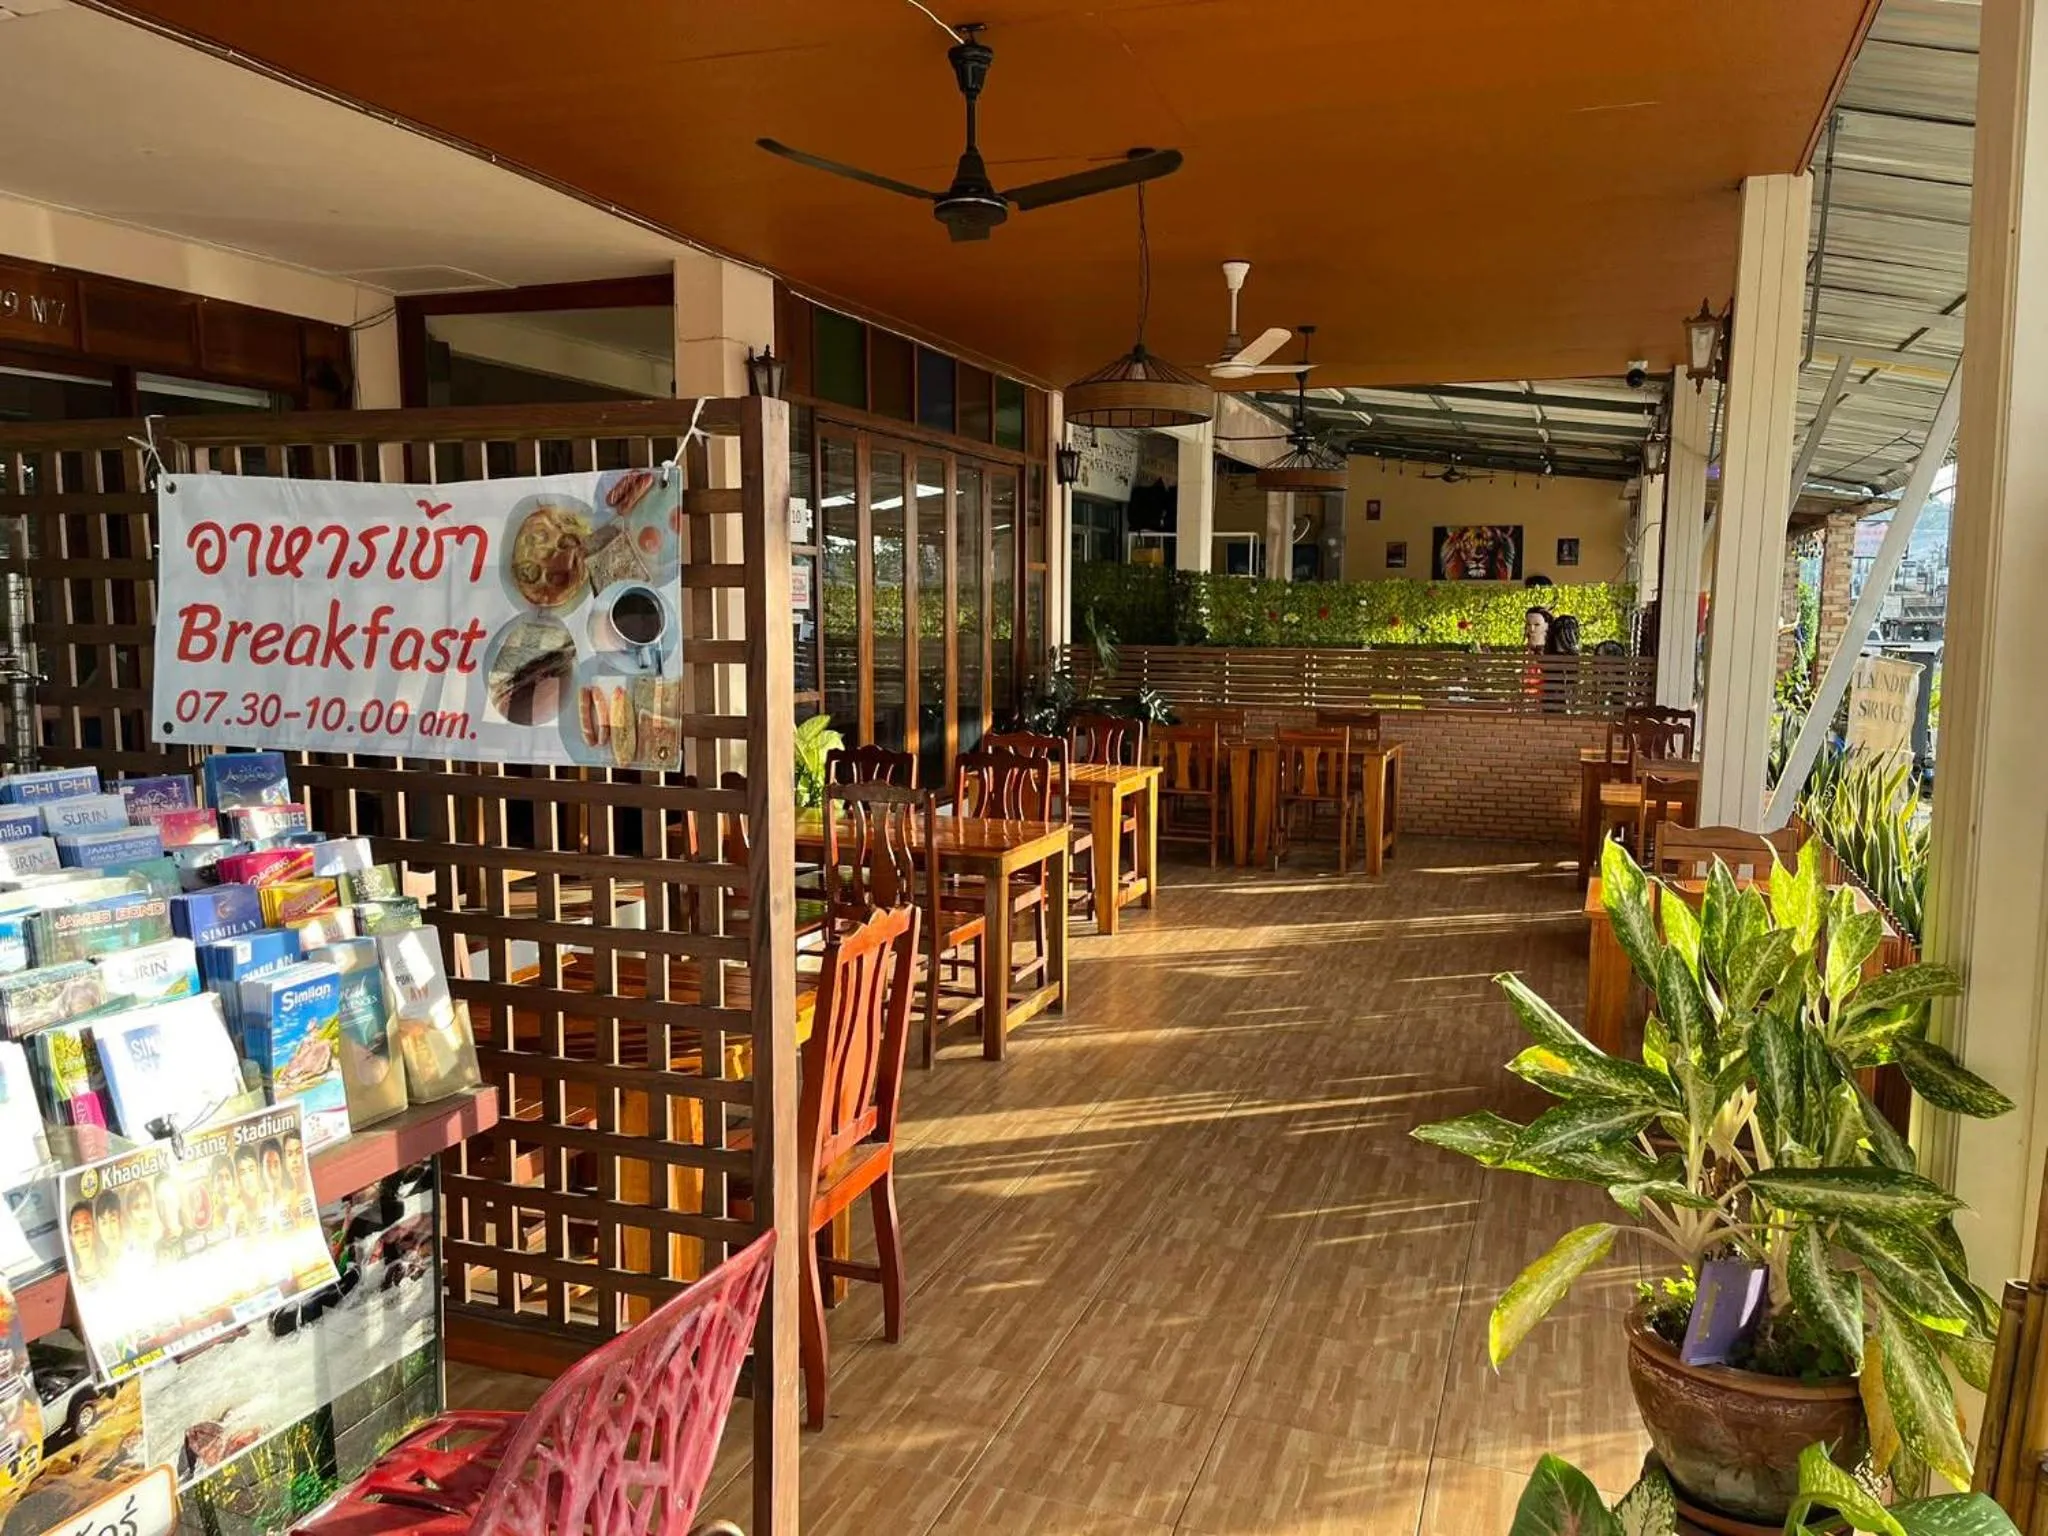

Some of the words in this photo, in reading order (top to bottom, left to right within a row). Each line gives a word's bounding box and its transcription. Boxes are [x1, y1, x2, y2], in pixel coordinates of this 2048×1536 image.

[187, 499, 489, 583] อาหารเช้า
[176, 598, 487, 674] Breakfast
[175, 689, 408, 735] 07.30-10.00
[418, 710, 478, 740] am.
[21, 783, 54, 797] PHI
[58, 777, 92, 792] PHI
[62, 808, 109, 827] SURIN
[115, 902, 166, 921] BOND
[200, 919, 258, 943] SIMILAN
[281, 982, 332, 1012] Similan
[233, 1113, 296, 1146] Stadium
